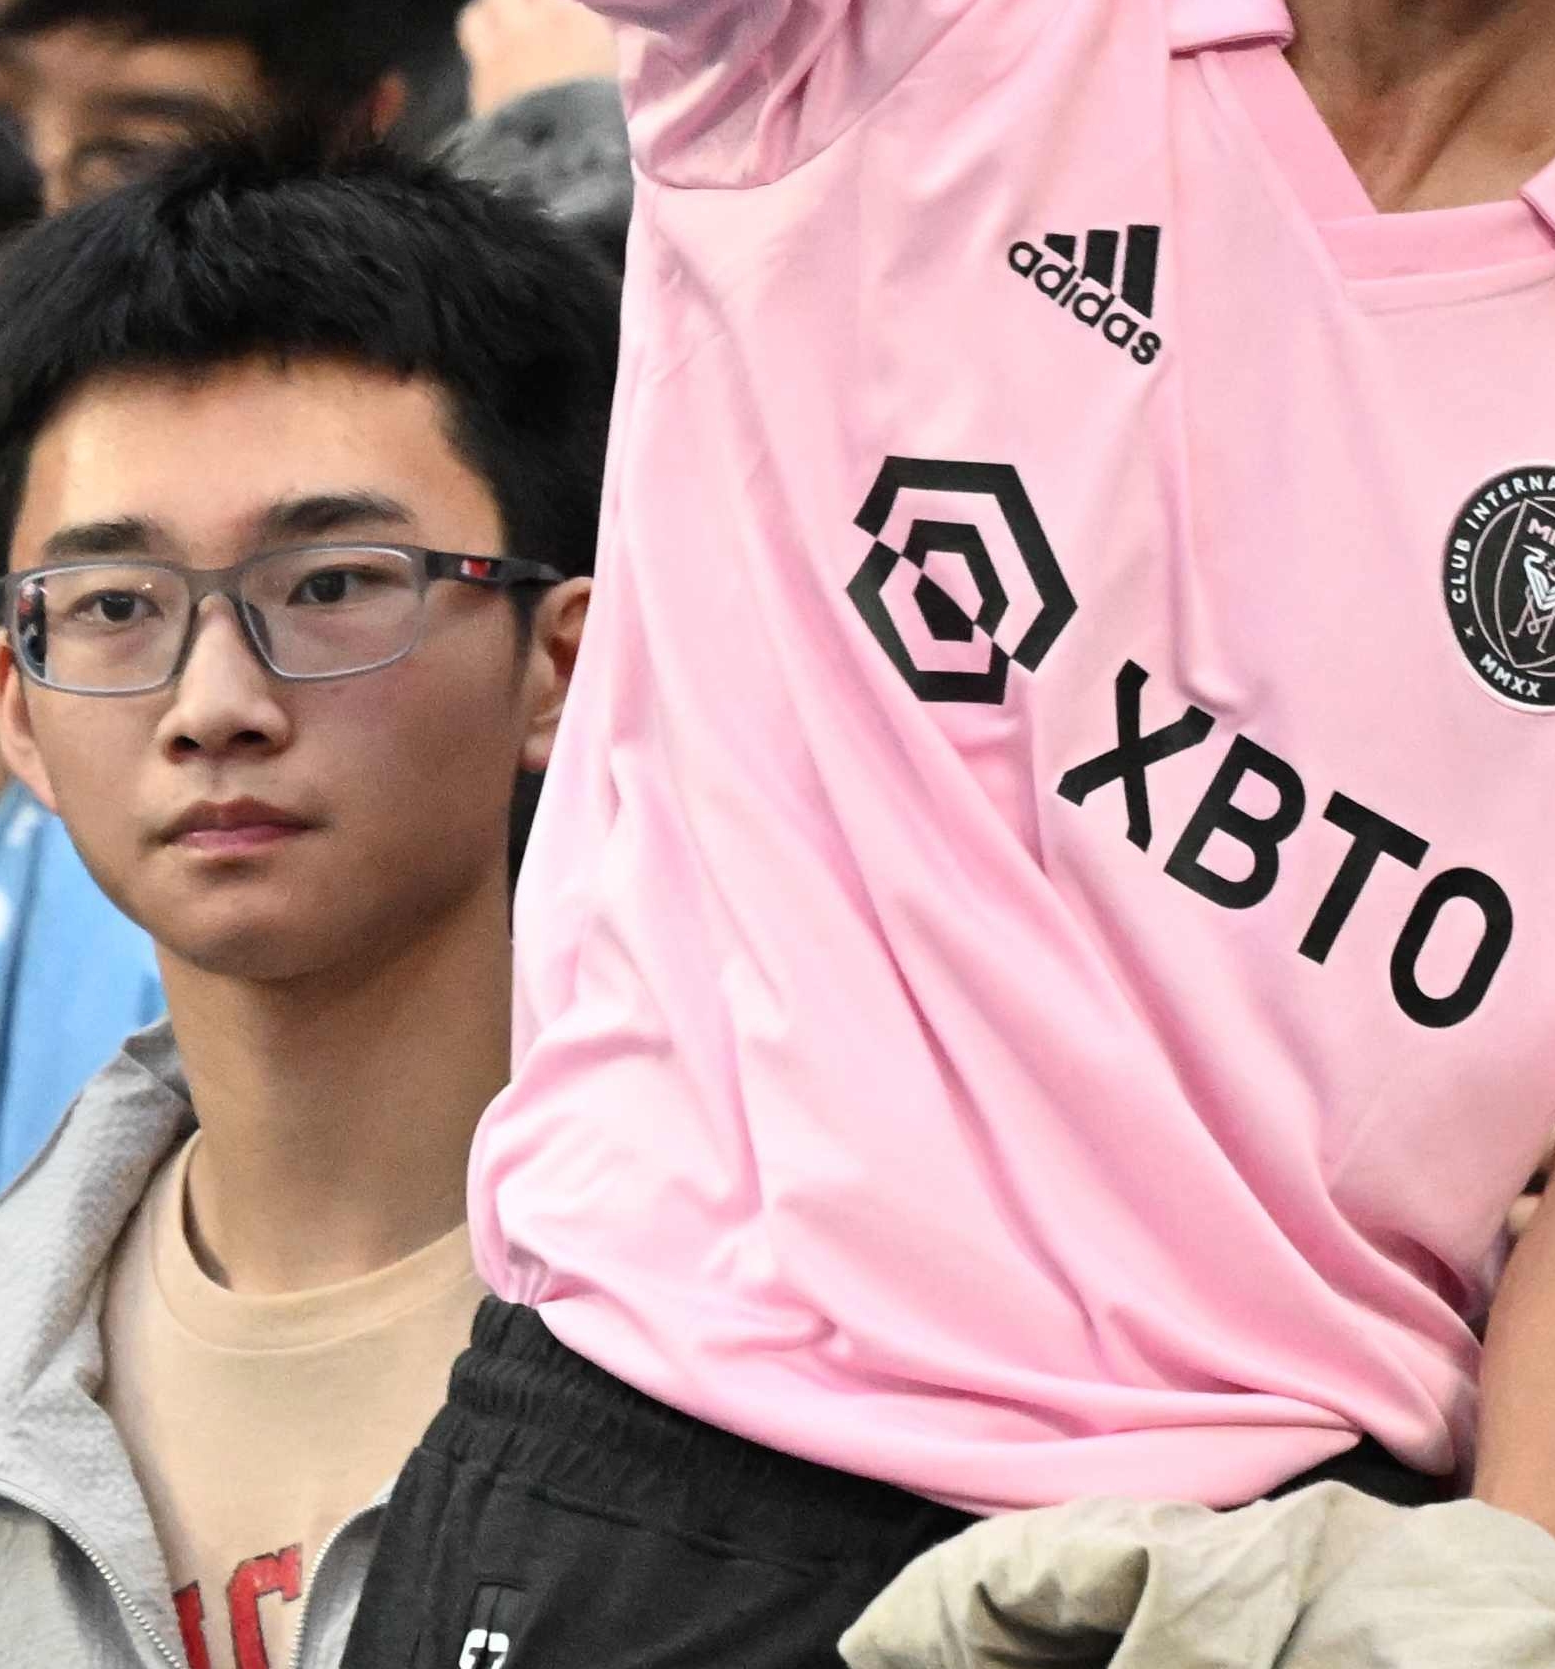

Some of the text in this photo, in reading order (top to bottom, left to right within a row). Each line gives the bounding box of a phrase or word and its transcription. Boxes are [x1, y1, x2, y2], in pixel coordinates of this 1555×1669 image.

[1008, 240, 1162, 365] adidas
[1450, 539, 1471, 604] CLUB
[1479, 652, 1542, 699] MMXX
[1056, 658, 1514, 1028] XBTO
